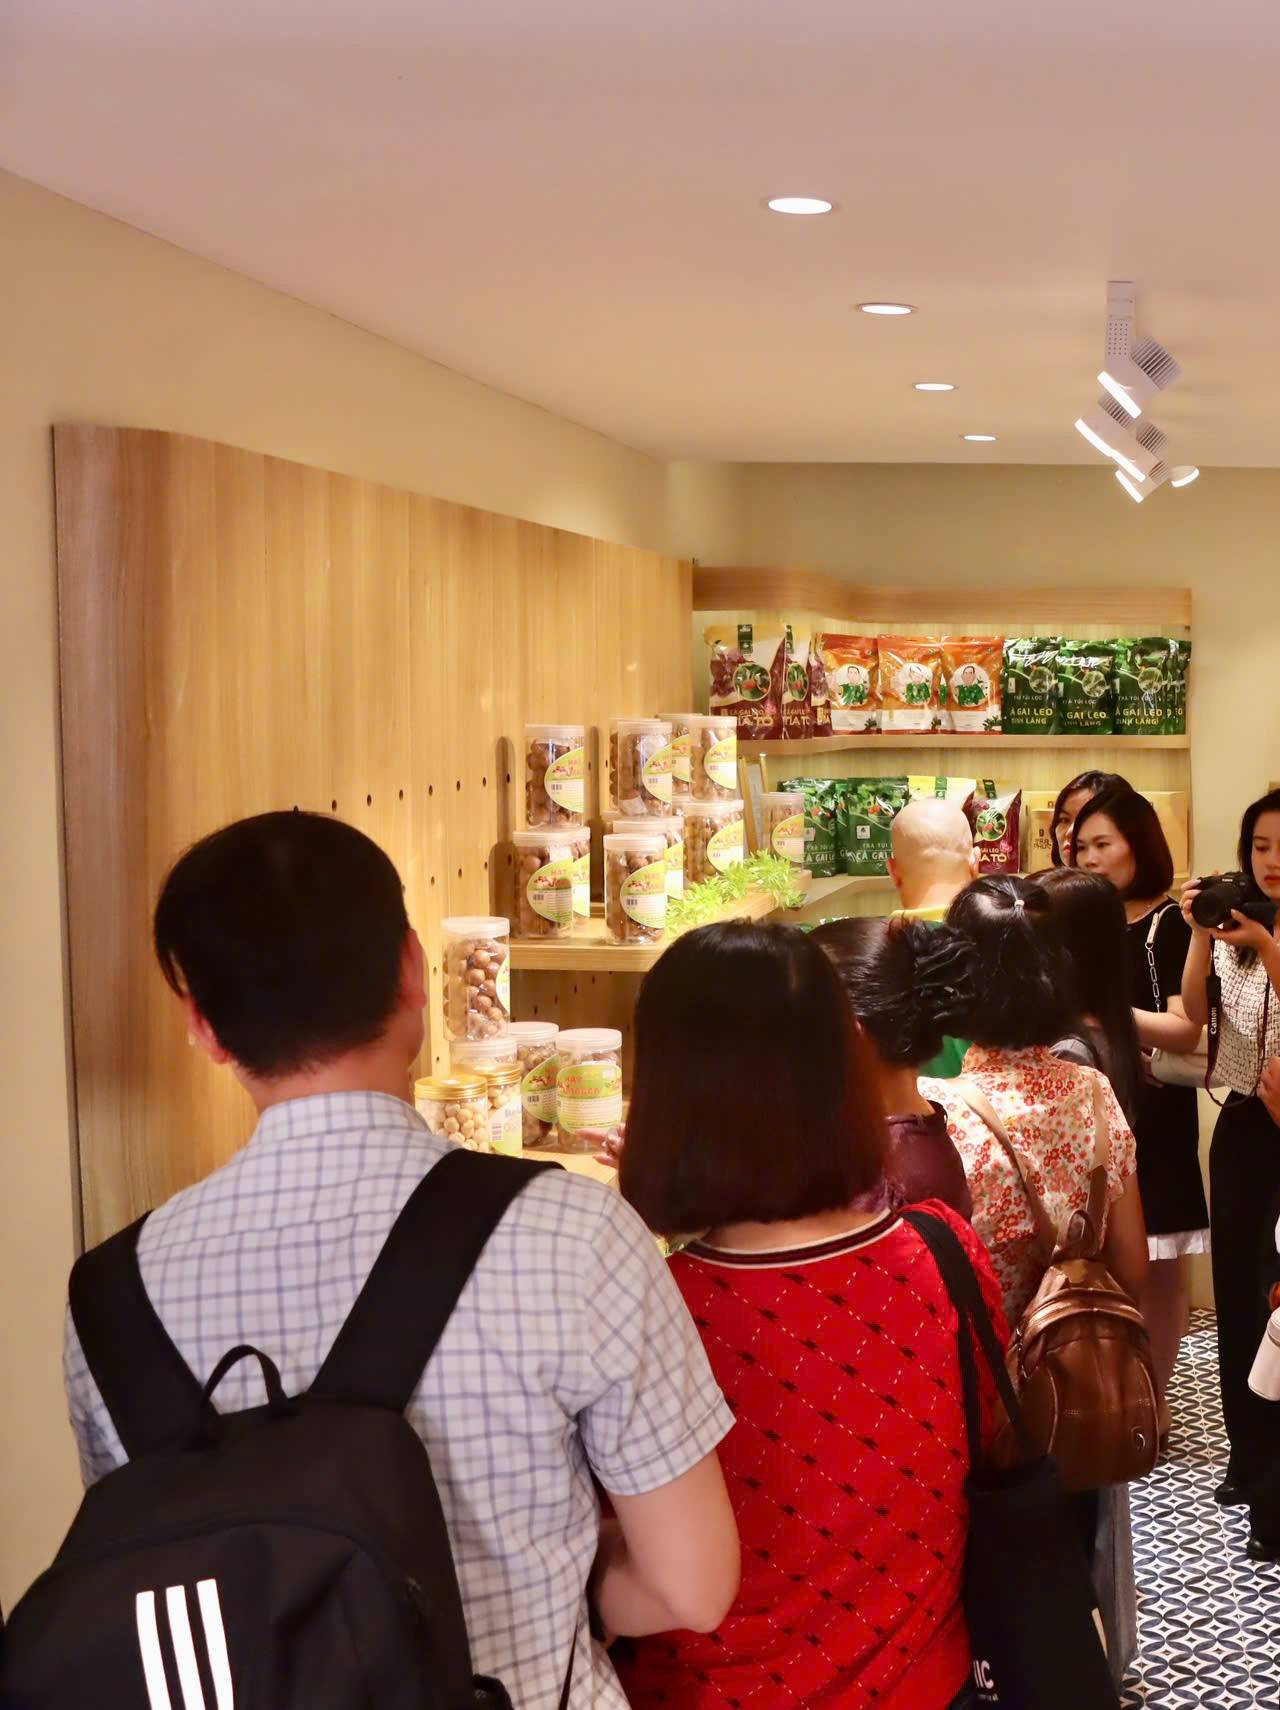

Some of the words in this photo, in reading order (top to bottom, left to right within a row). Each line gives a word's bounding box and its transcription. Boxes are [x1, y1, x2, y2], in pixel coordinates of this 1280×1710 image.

[1017, 707, 1030, 716] GAI
[1034, 707, 1053, 716] LEO
[1067, 711, 1084, 720] GAI
[1087, 711, 1107, 719] LEO
[1123, 708, 1140, 717] GAI
[1144, 707, 1163, 717] LEO
[872, 851, 888, 860] GAI
